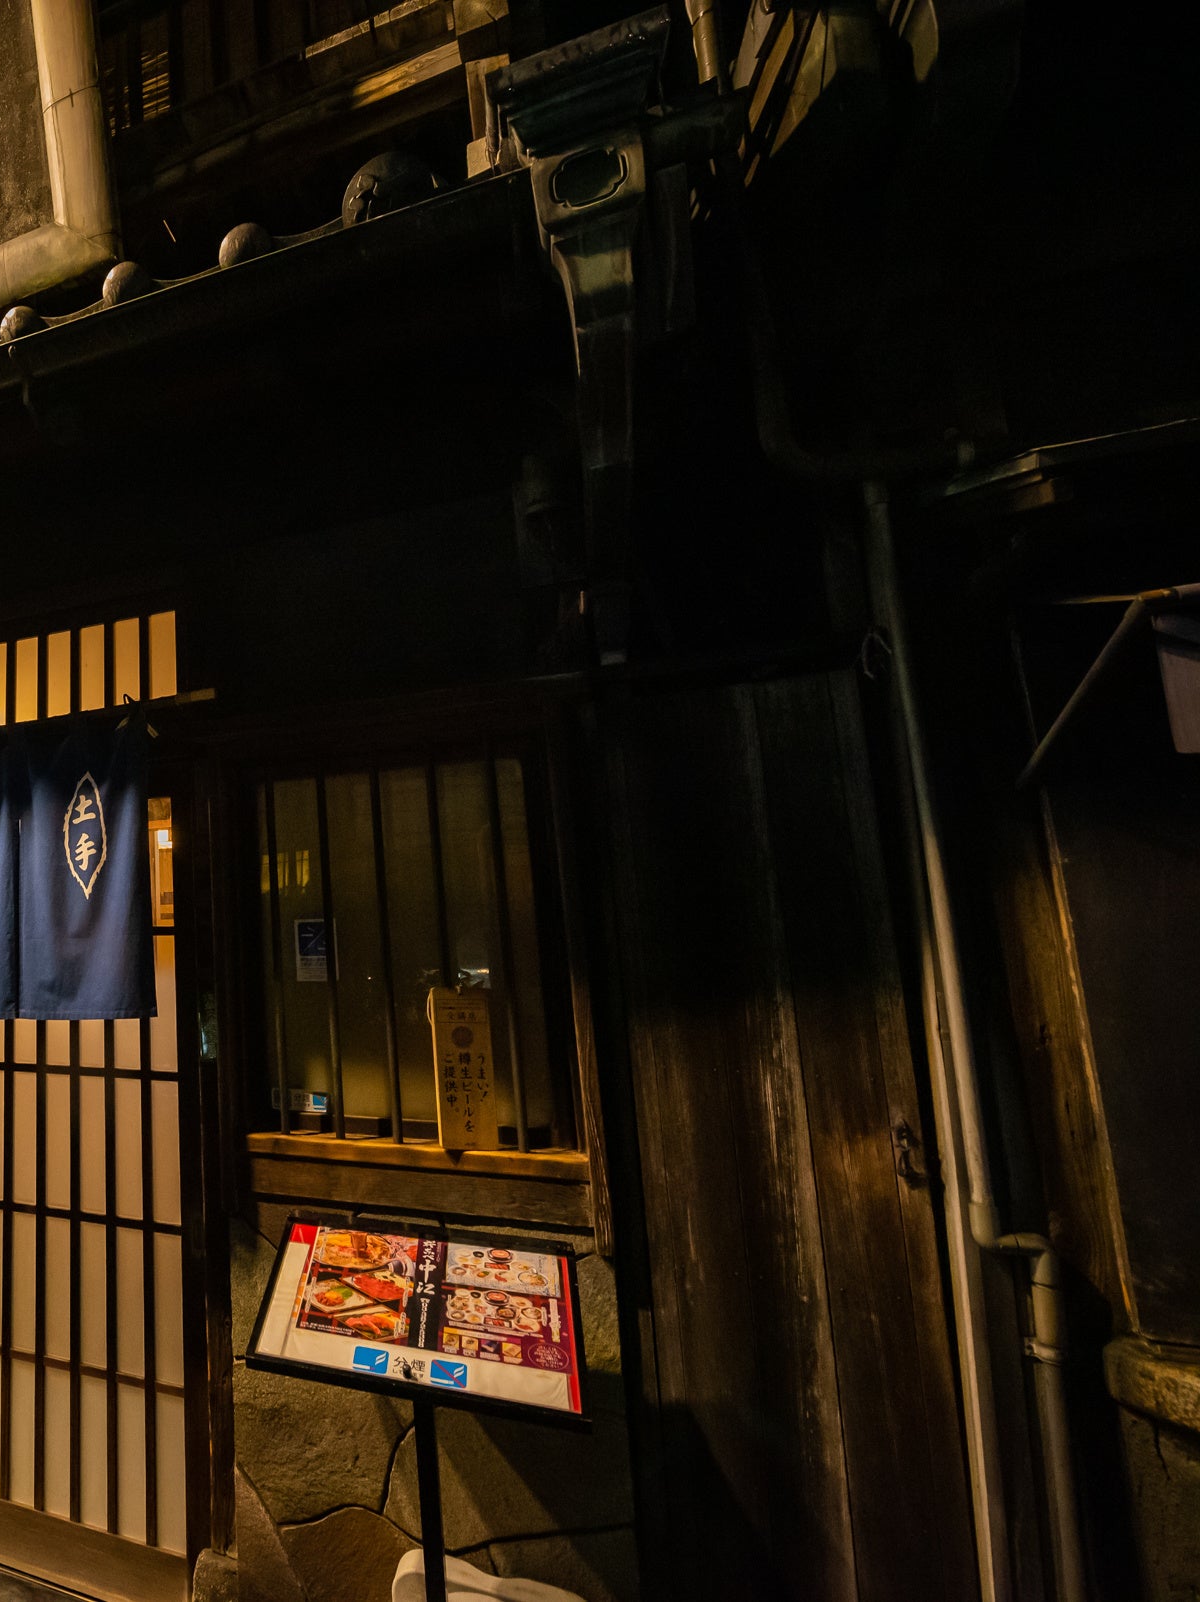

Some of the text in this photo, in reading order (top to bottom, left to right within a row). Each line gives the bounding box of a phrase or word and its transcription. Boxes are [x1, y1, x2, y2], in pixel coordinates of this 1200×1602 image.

[72, 793, 97, 872] 土手
[458, 1052, 476, 1133] 樽生ビールを
[416, 1259, 437, 1295] 中江
